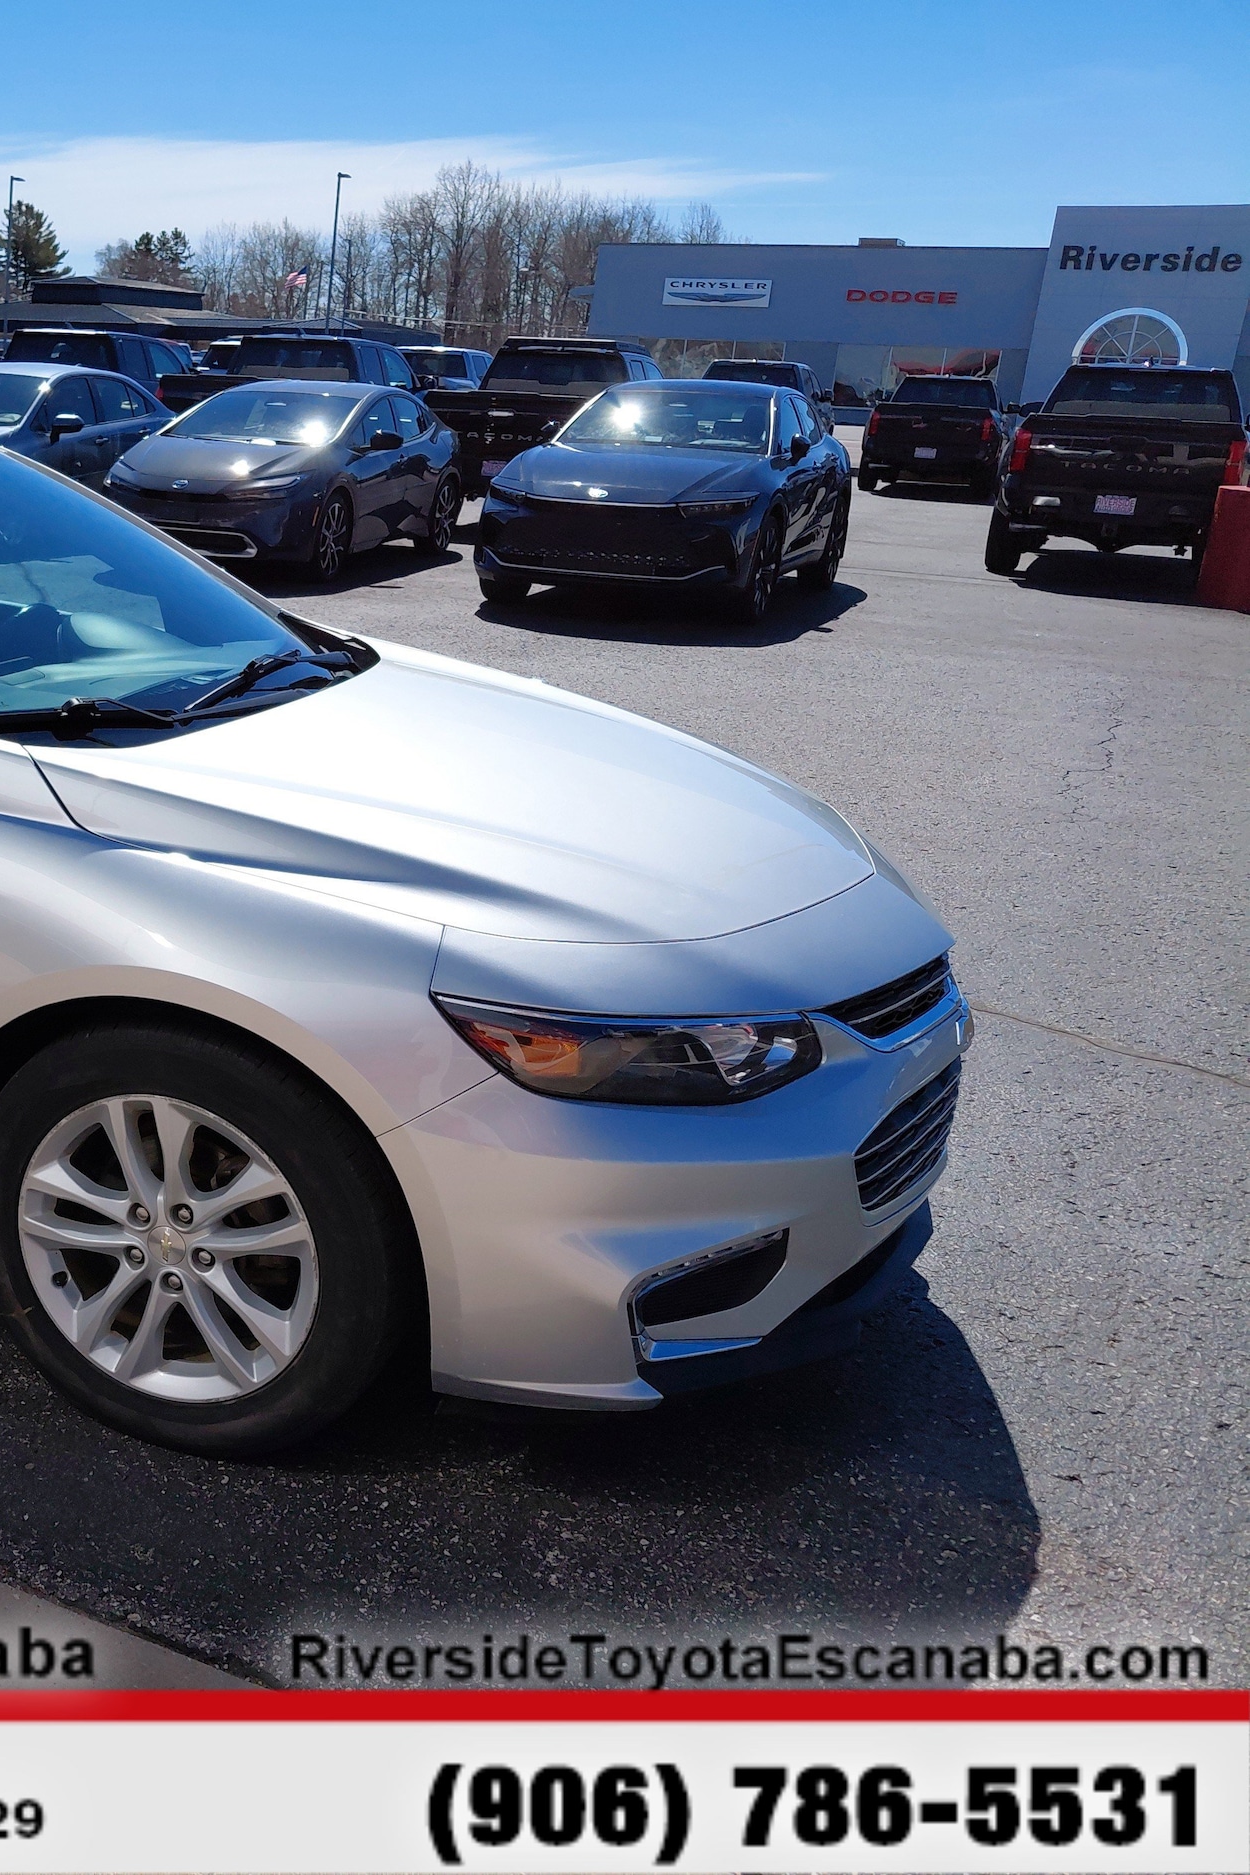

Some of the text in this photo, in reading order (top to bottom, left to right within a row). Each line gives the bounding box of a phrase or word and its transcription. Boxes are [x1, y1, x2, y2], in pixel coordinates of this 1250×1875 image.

[1059, 245, 1242, 272] Riverside
[669, 280, 768, 290] CHRYSLER
[845, 289, 959, 305] DODGE
[1060, 460, 1190, 475] TACOMA
